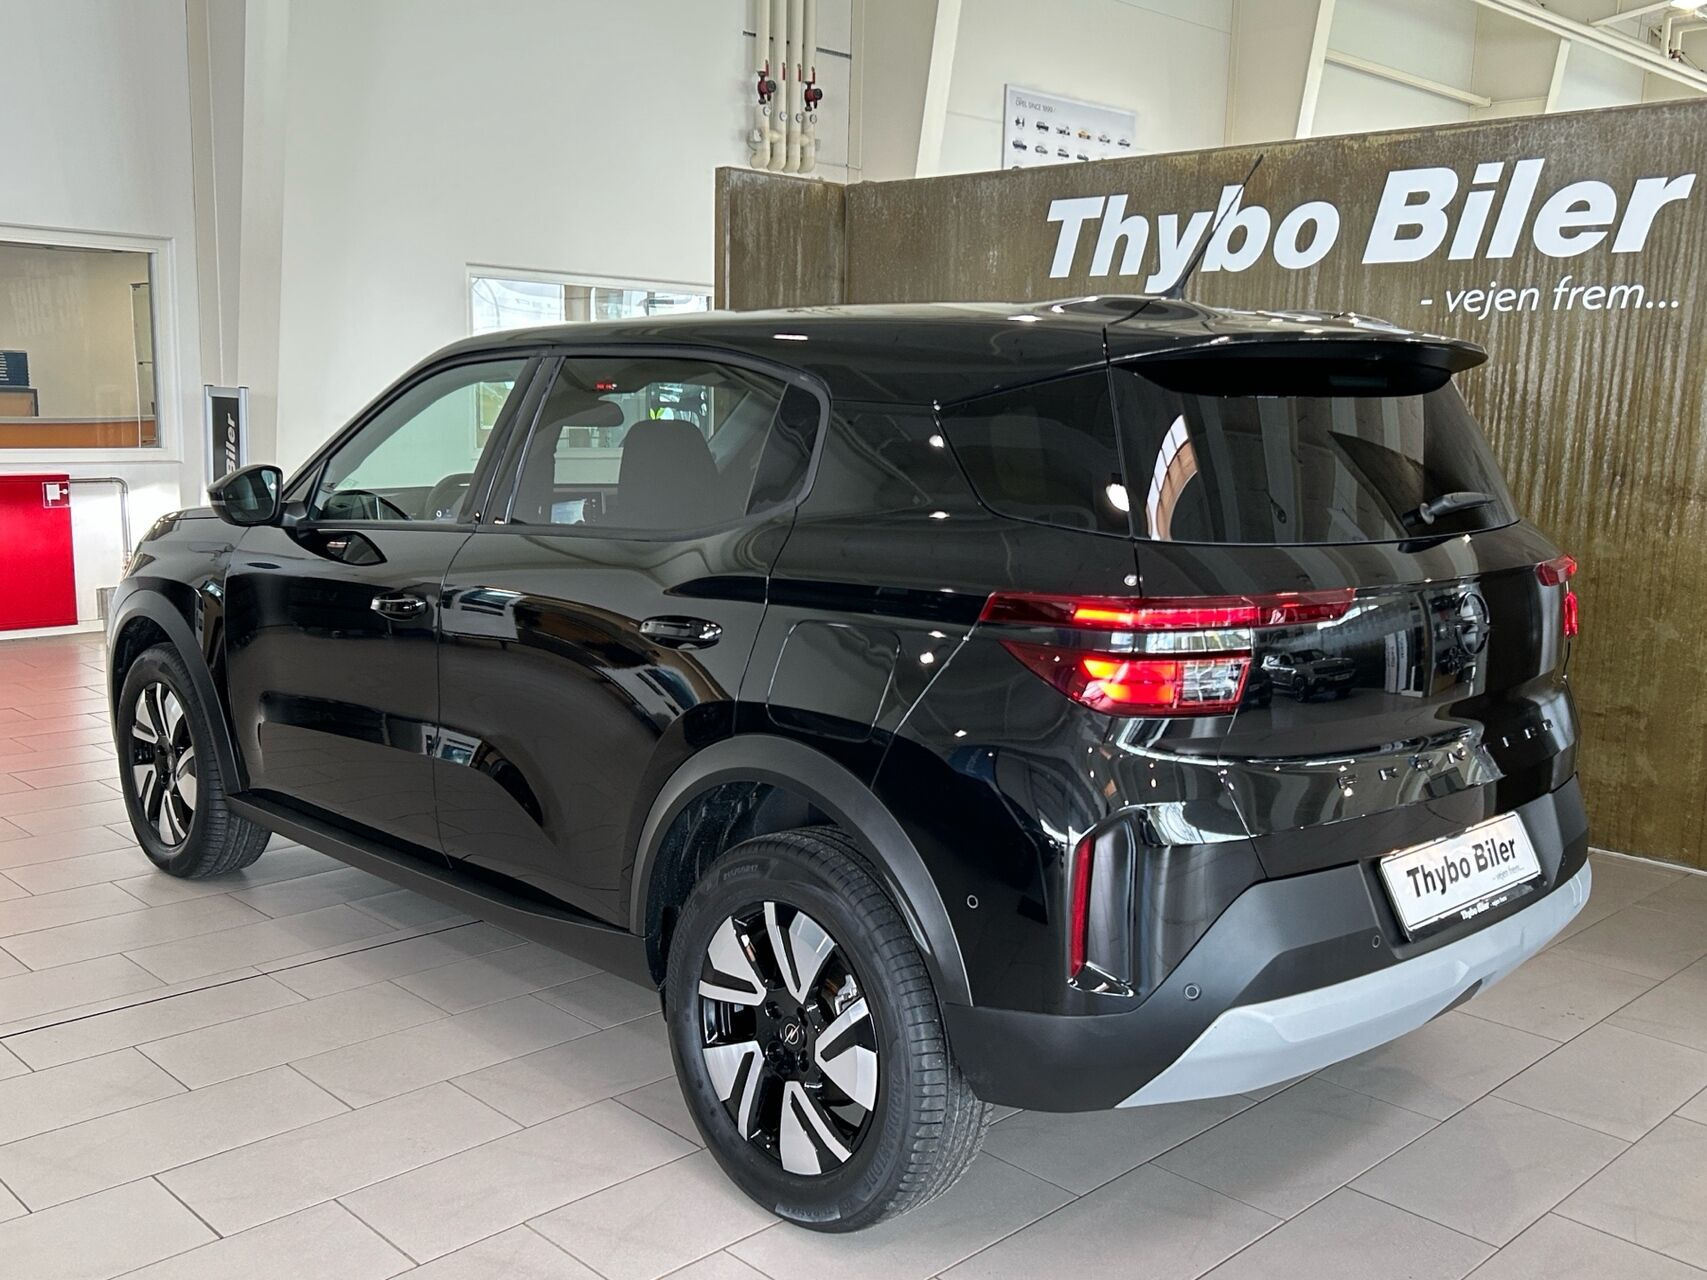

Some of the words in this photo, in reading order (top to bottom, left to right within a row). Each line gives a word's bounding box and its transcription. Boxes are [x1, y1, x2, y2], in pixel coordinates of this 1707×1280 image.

[1047, 184, 1340, 294] Thybo
[1362, 158, 1696, 264] Biler
[1445, 281, 1540, 320] vejen
[1552, 275, 1679, 310] frem...
[225, 412, 236, 475] Biler
[1406, 856, 1471, 898] Thybo
[1472, 838, 1516, 873] Biler
